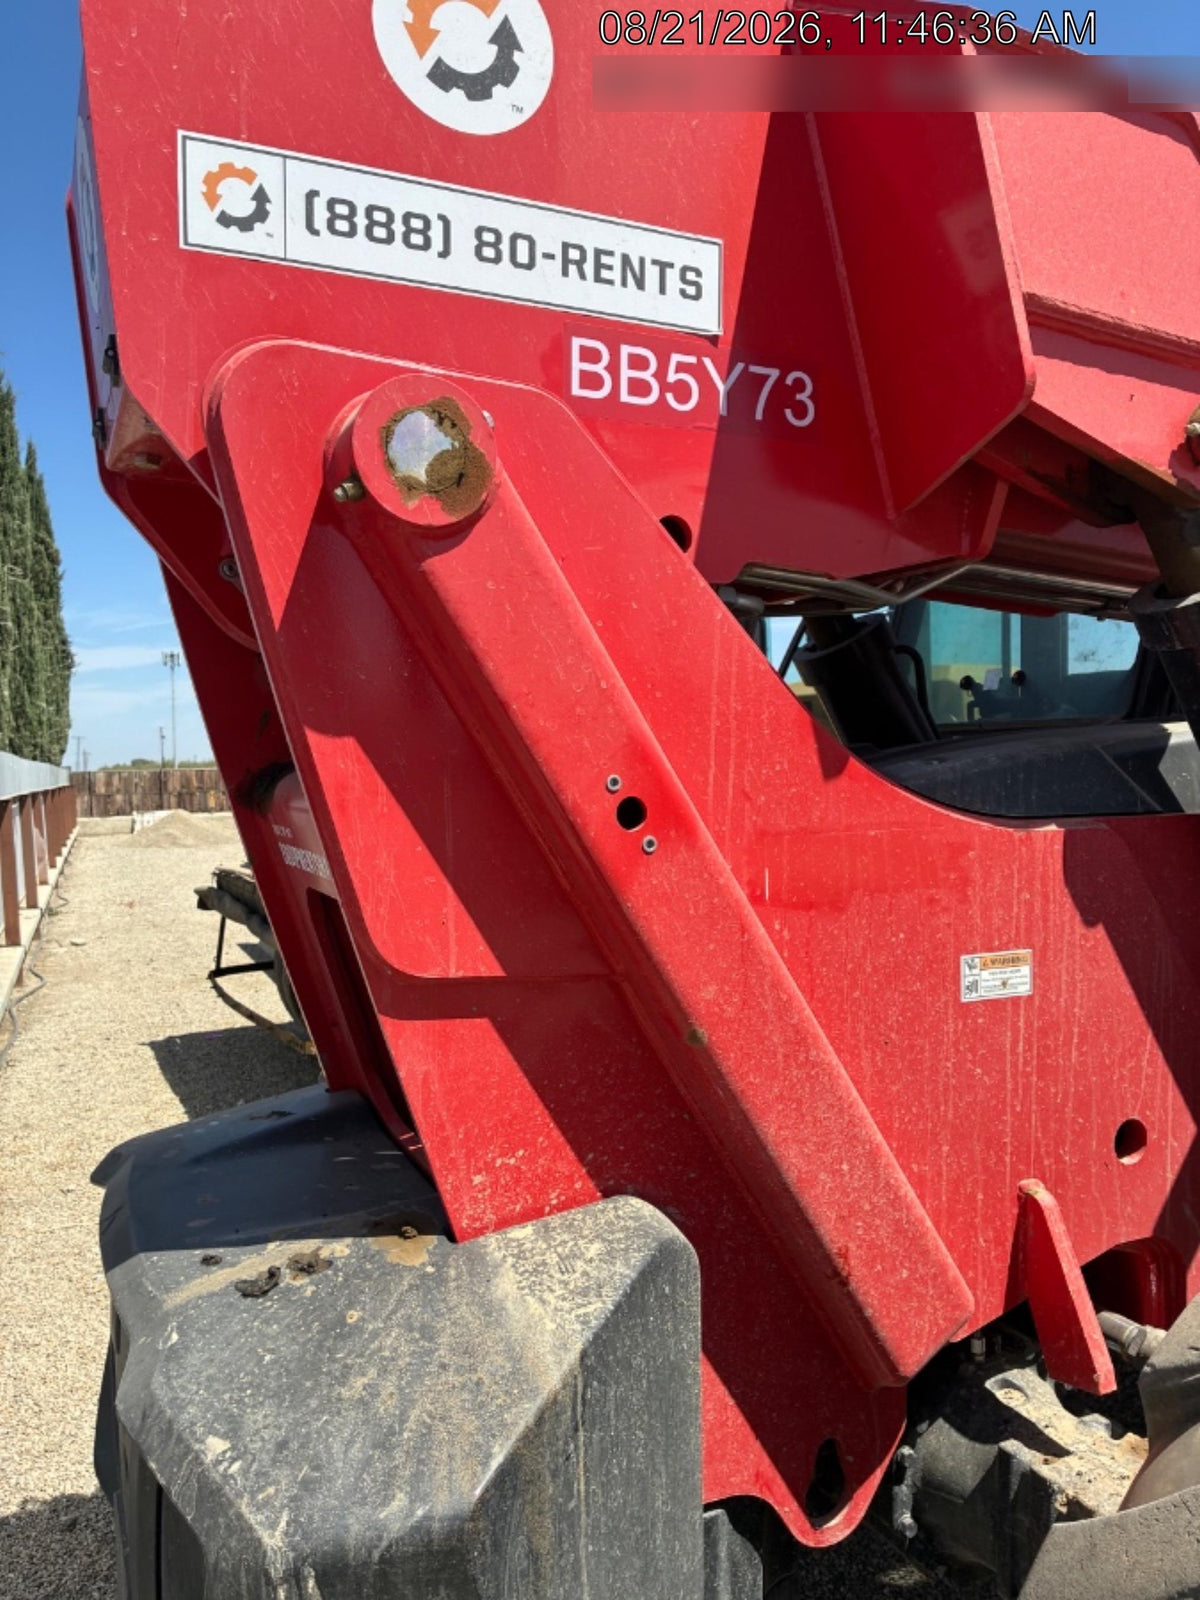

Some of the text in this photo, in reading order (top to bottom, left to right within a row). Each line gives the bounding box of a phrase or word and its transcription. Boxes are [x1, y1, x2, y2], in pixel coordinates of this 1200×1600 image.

[304, 189, 704, 302] (888) 80-RENTS
[570, 336, 815, 428] BB5Y73
